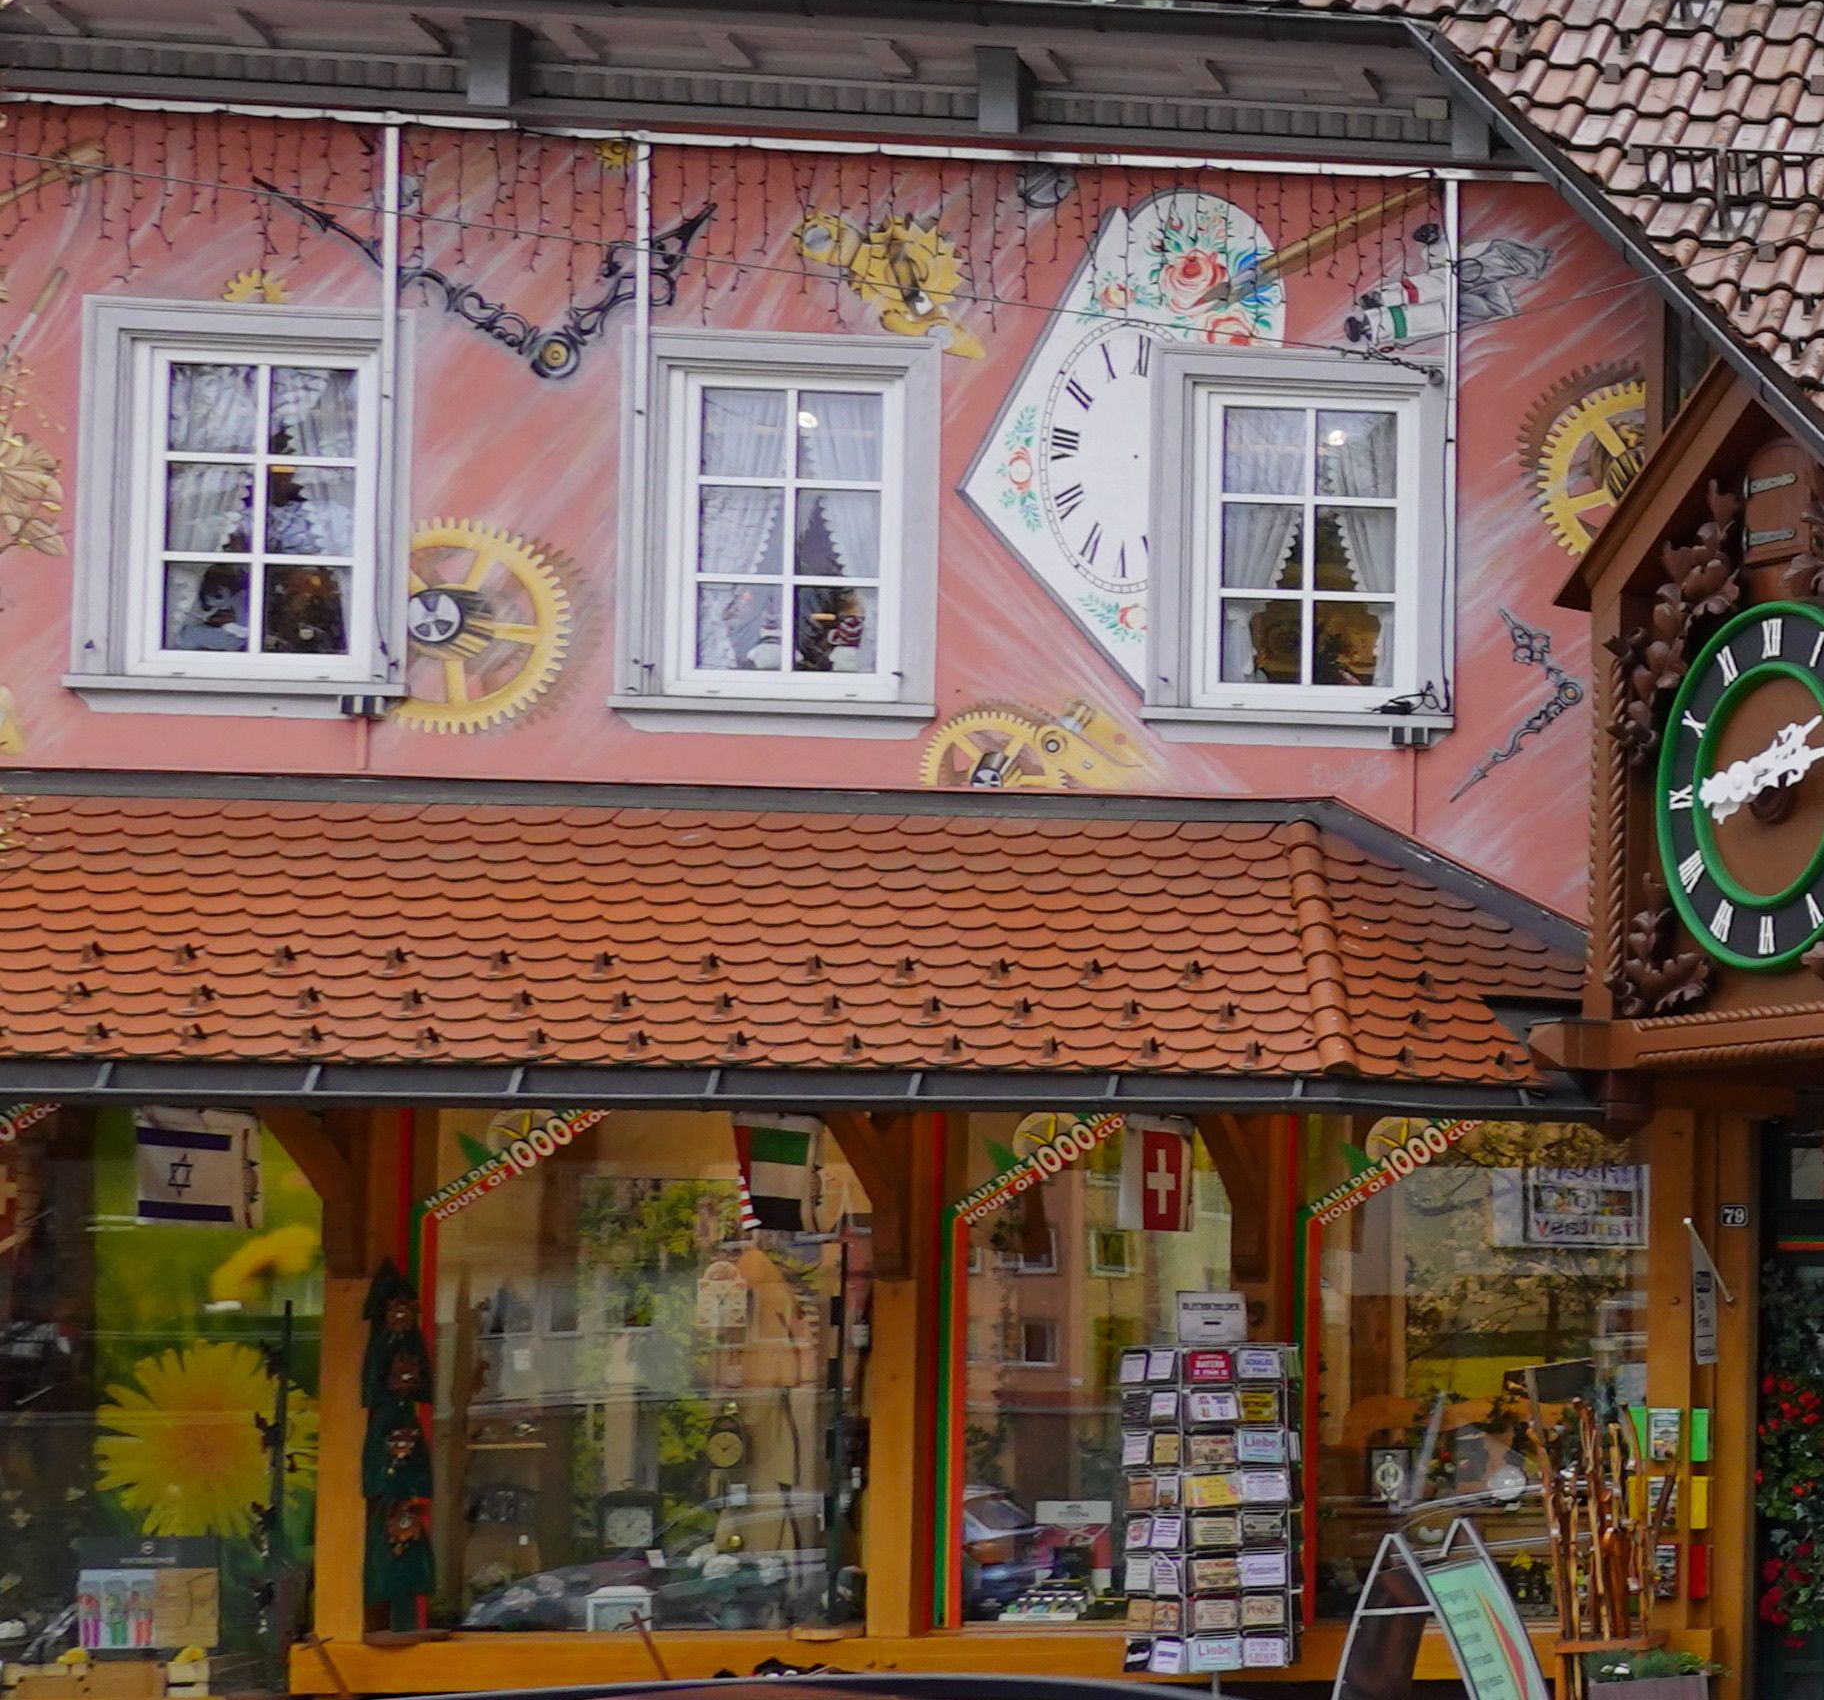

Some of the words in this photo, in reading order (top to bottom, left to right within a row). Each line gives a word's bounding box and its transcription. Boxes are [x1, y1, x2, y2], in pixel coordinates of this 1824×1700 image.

[424, 1179, 467, 1208] HAUS
[470, 1158, 499, 1181] DER
[501, 1117, 573, 1175] 1000
[955, 1183, 995, 1212] HAUS
[998, 1163, 1027, 1185] DER
[1028, 1122, 1096, 1181] 1000
[1310, 1184, 1349, 1214] HAUS
[1351, 1166, 1379, 1189] DER
[1380, 1126, 1448, 1182] 1000
[434, 1185, 484, 1221] HOUSE
[488, 1168, 510, 1187] OF
[964, 1190, 1012, 1225] HOUSE
[1016, 1174, 1035, 1191] OF
[1319, 1193, 1366, 1226] HOUSE
[1368, 1177, 1388, 1194] OF
[1723, 1208, 1745, 1224] 79
